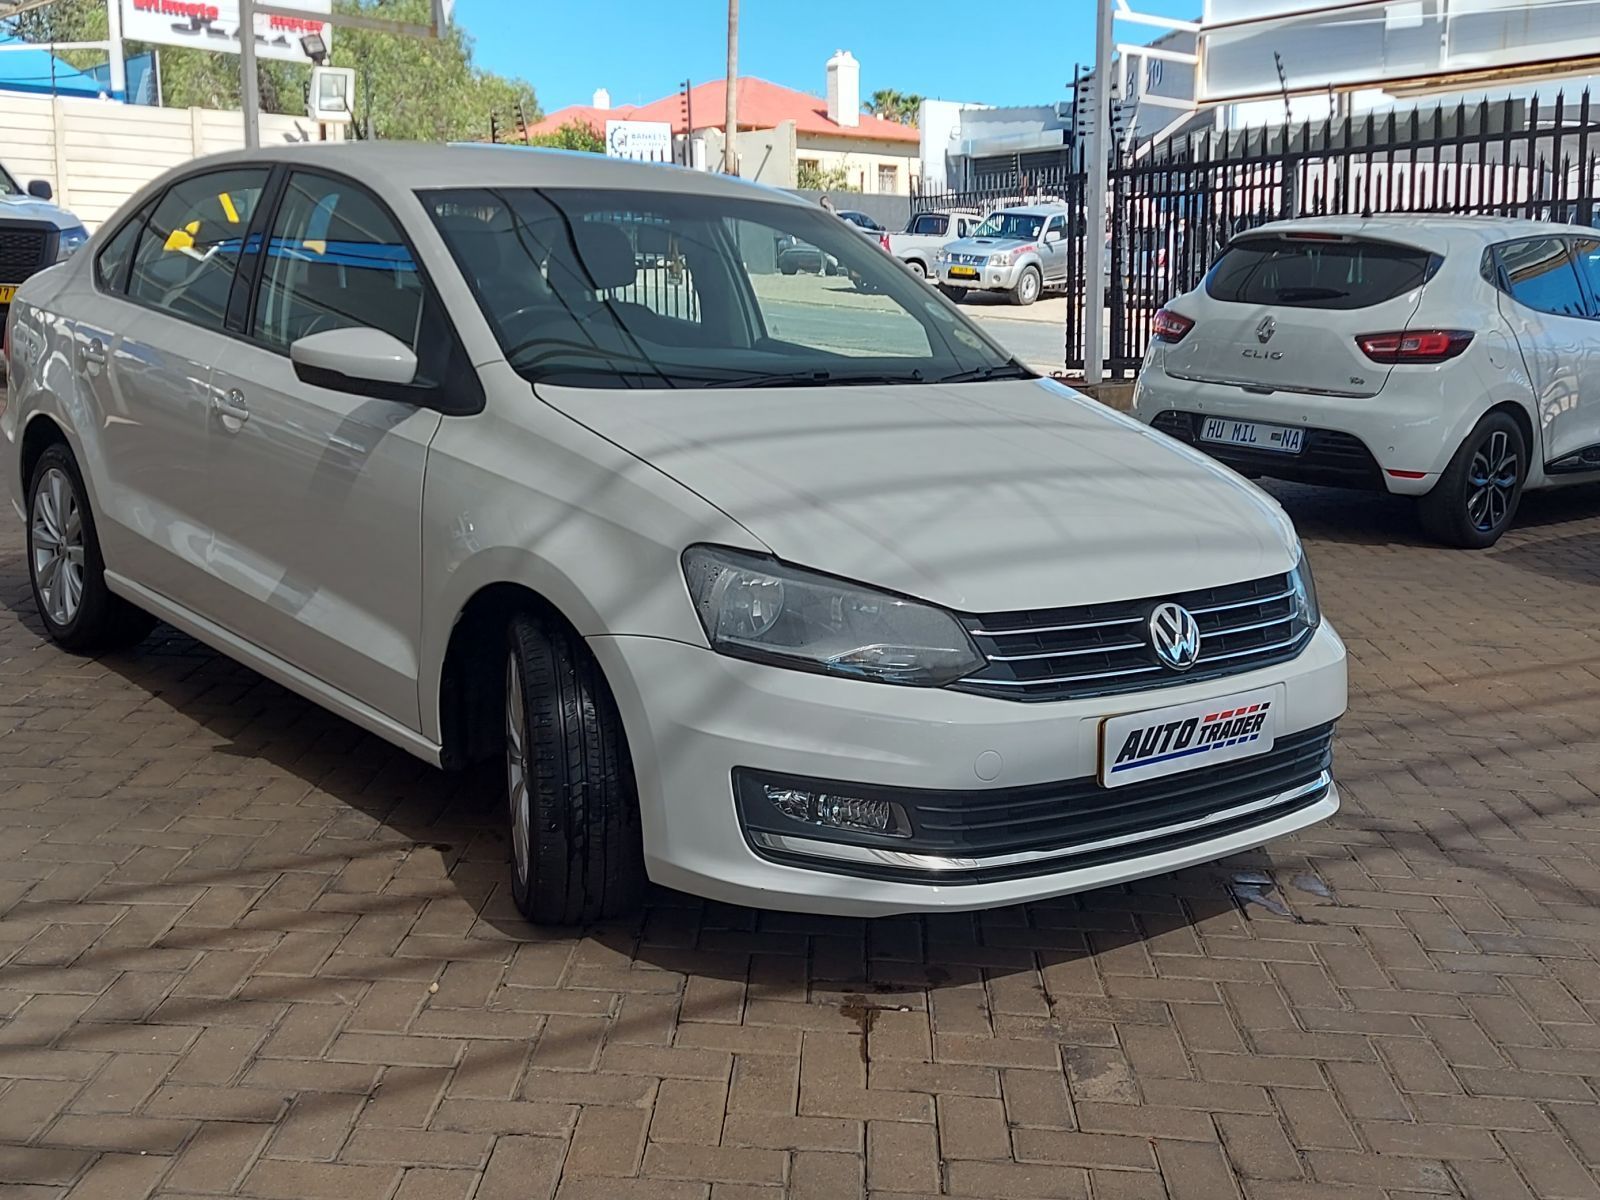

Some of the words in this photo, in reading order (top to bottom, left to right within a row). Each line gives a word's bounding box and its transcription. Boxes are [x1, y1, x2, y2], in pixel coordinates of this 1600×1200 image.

[1241, 348, 1284, 361] CLIO
[1206, 420, 1225, 439] HU
[1231, 423, 1257, 443] MIL
[1280, 429, 1300, 449] NA
[1115, 717, 1200, 764] AUTO
[1197, 712, 1267, 745] TRADER
